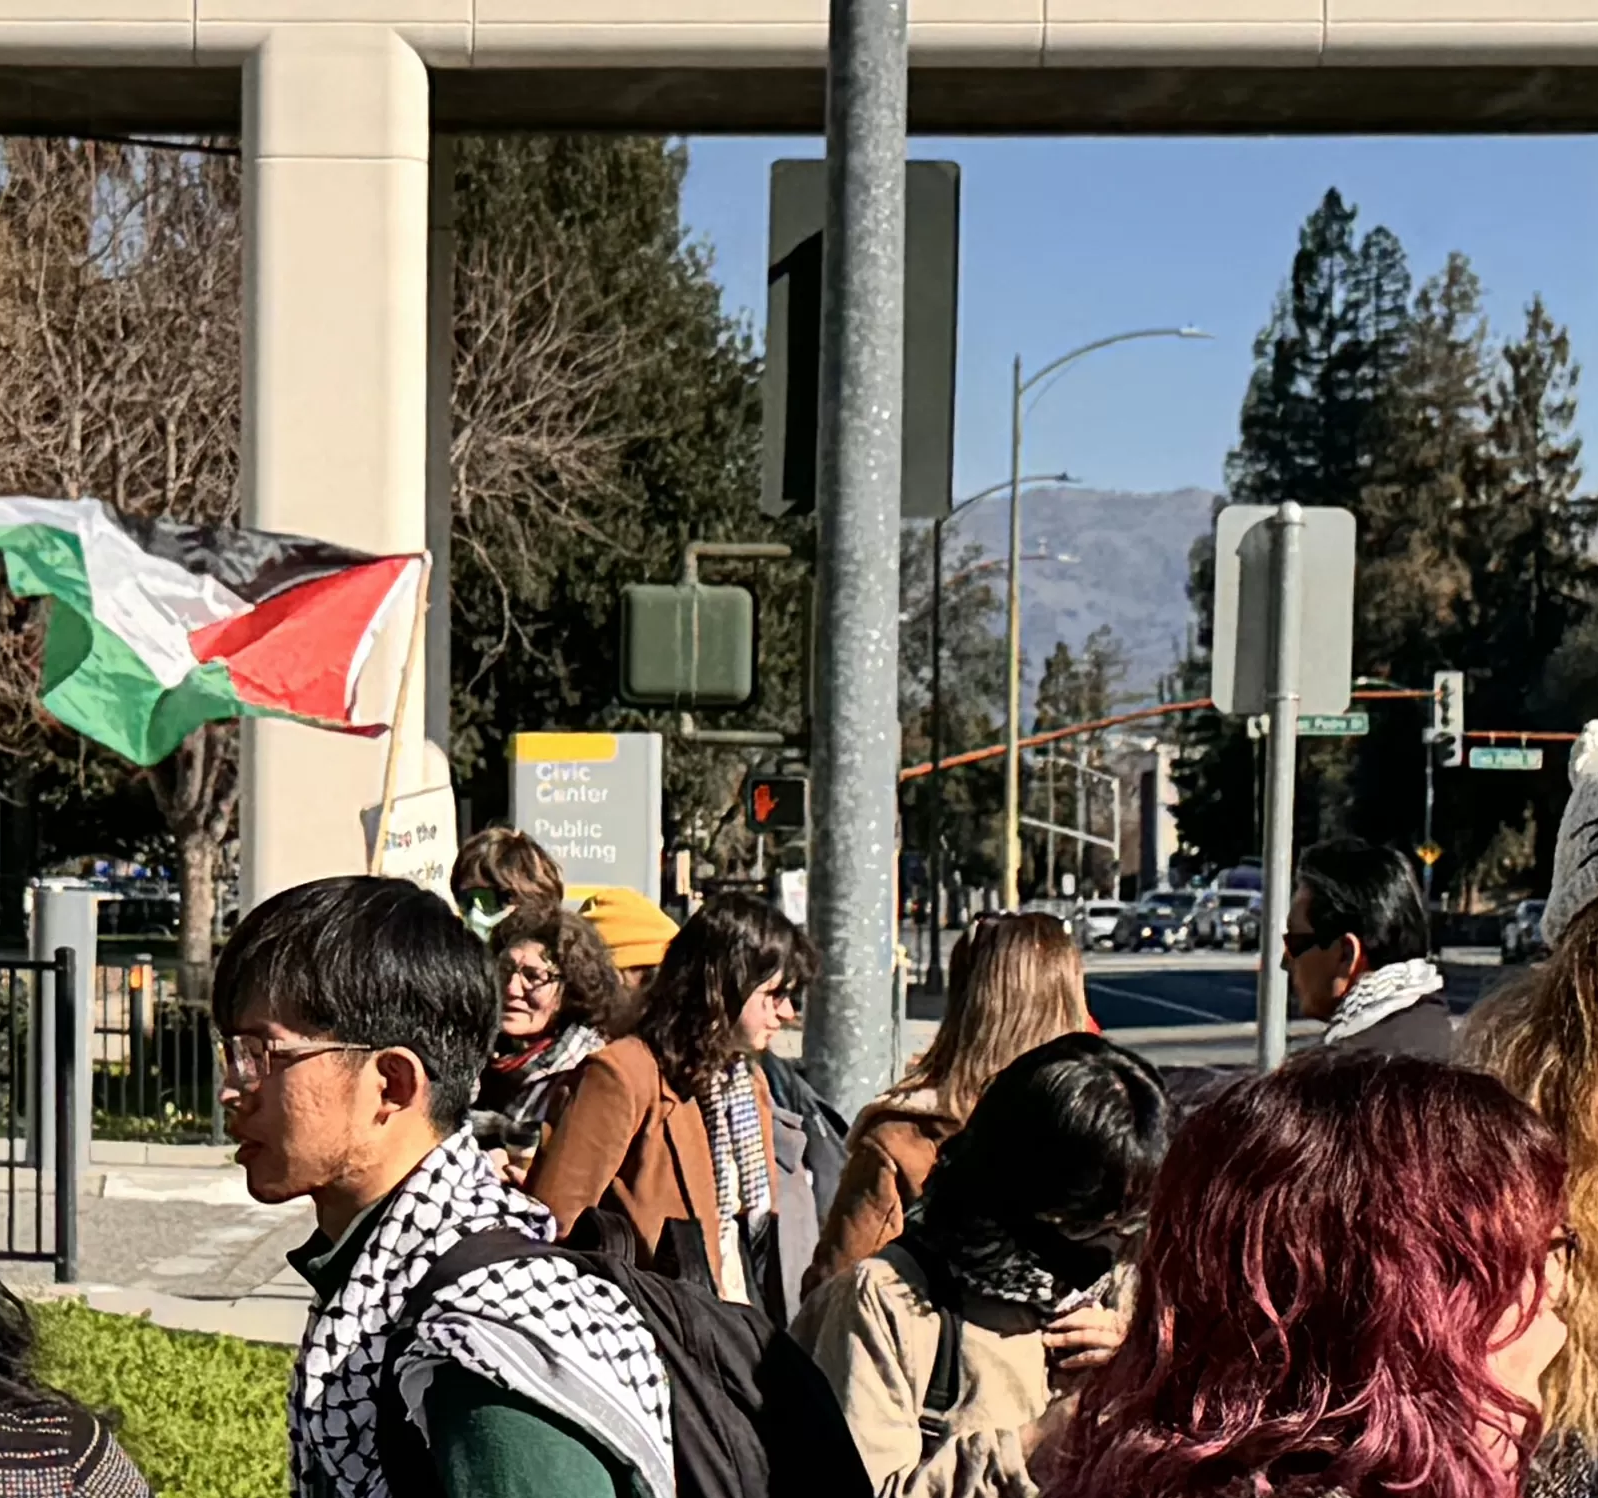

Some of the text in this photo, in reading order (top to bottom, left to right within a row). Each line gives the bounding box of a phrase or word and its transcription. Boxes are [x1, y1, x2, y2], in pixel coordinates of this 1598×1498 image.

[535, 762, 592, 782] Civic
[536, 783, 609, 803] Center
[534, 818, 603, 838] Public
